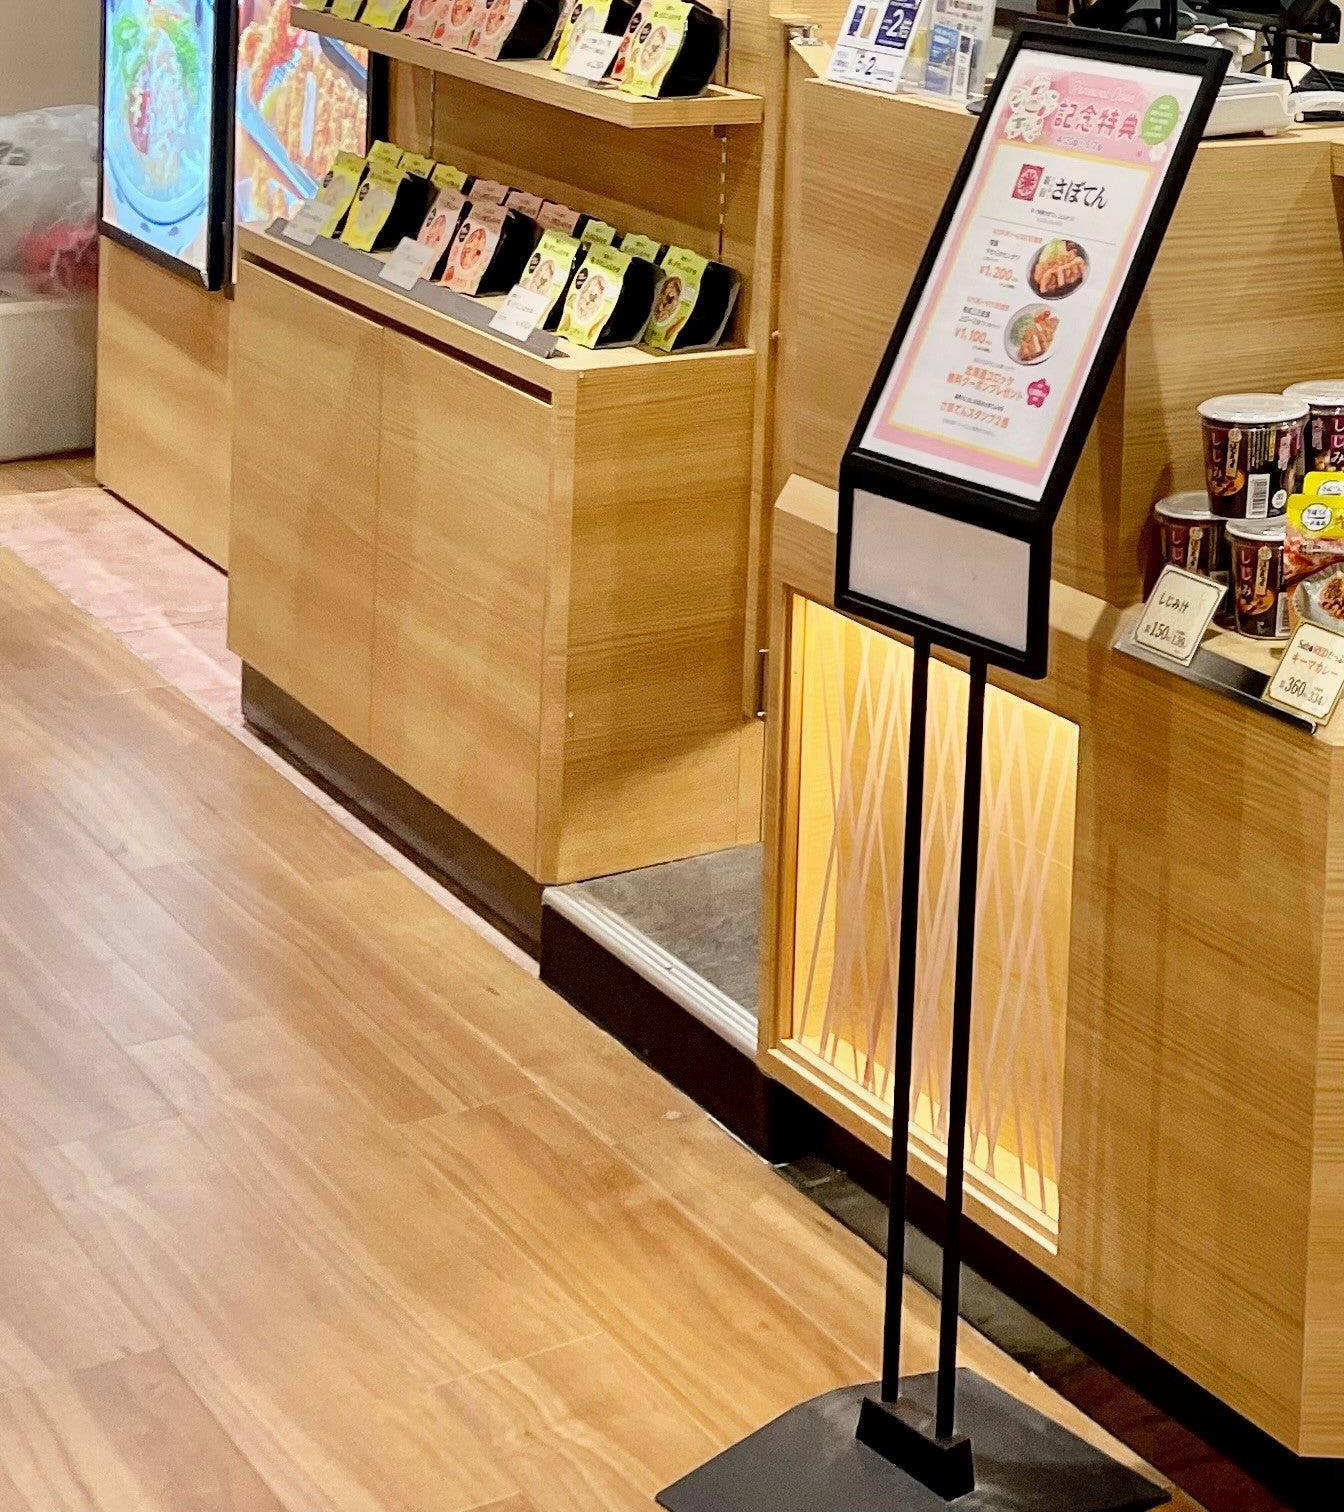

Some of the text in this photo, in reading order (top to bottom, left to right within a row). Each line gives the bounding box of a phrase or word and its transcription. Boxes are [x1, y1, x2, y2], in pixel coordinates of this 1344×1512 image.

[1052, 177, 1108, 210] さぼてん
[1212, 432, 1222, 478] しじみ
[1241, 550, 1252, 596] しじみ
[1292, 655, 1338, 676] キーマカレー
[1285, 677, 1306, 697] 360
